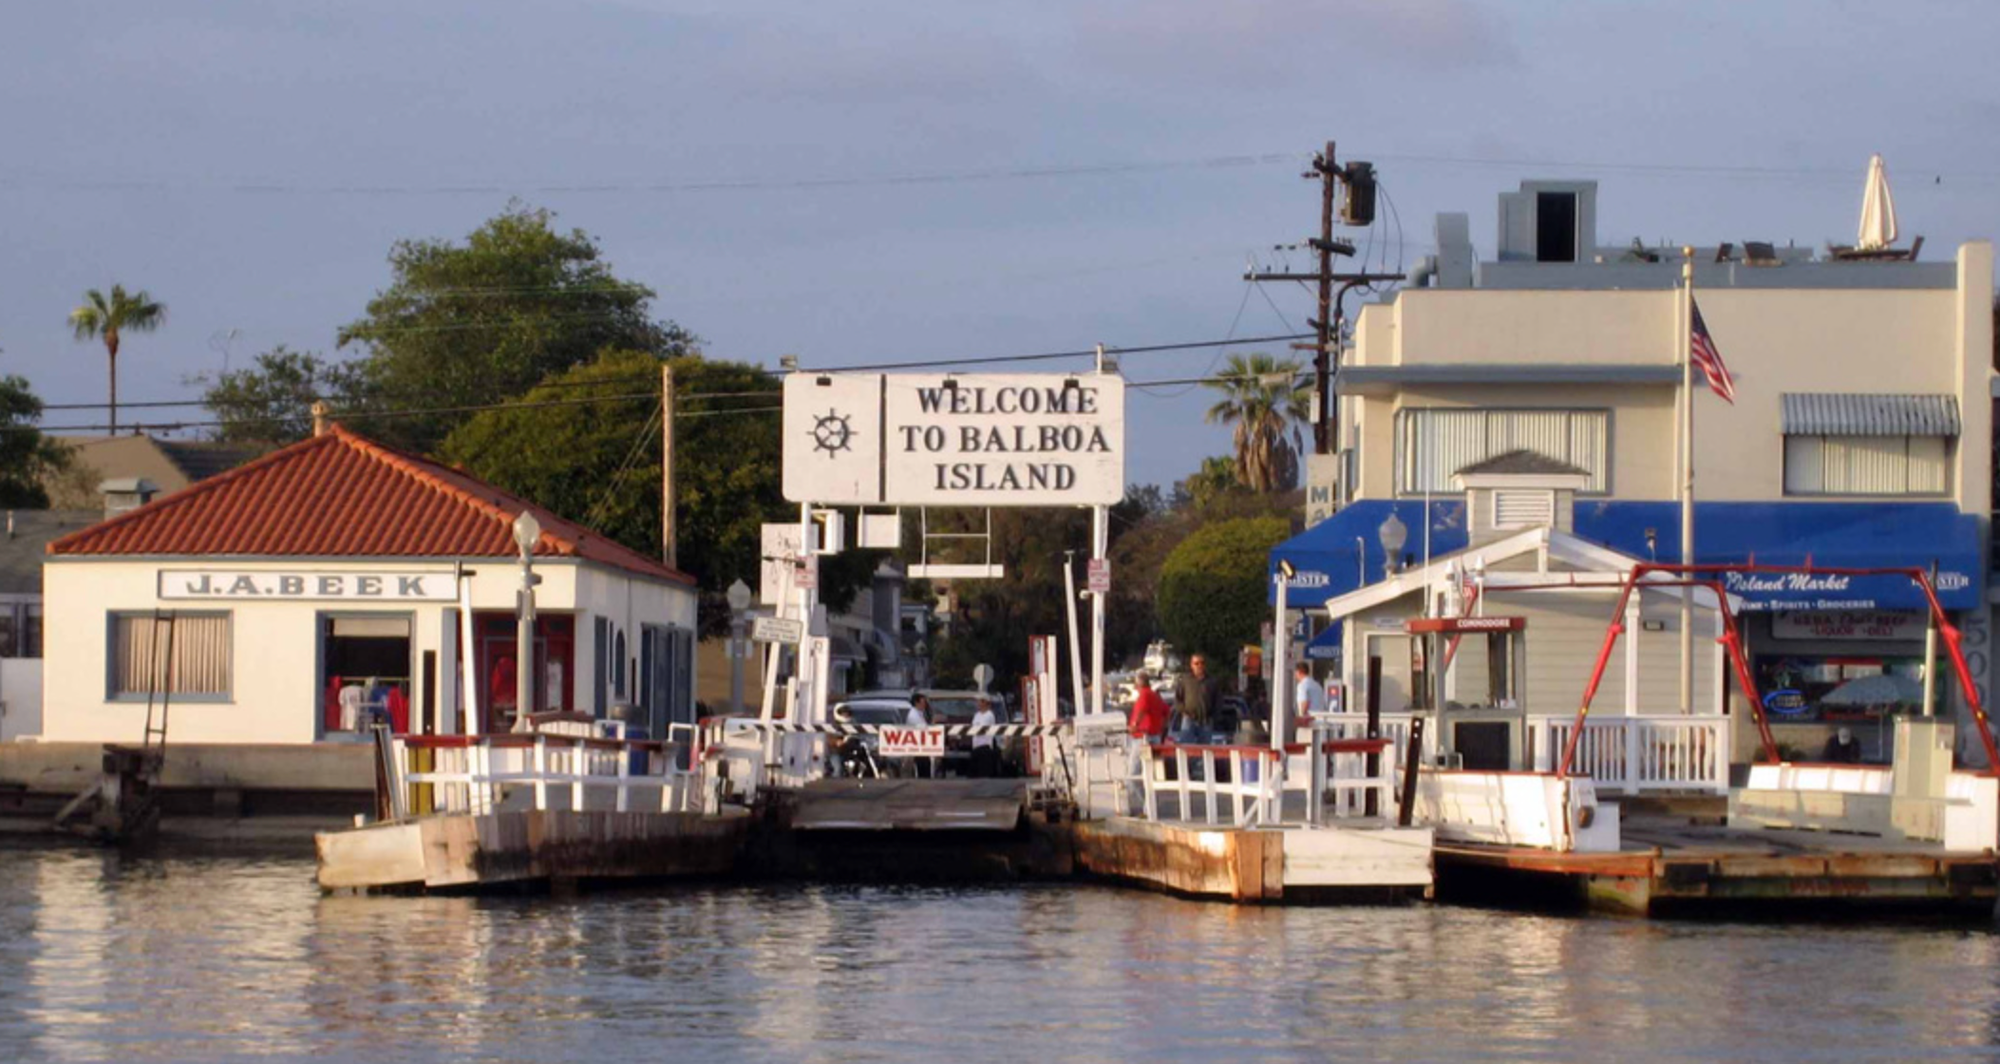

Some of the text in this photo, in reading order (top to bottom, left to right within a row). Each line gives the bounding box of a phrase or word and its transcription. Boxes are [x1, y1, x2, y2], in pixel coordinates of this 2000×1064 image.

[917, 387, 1098, 414] WELCOME
[899, 425, 1112, 452] TO BALBOA
[934, 463, 1076, 490] ISLAND
[1273, 572, 1330, 587] RGISTER
[1787, 572, 1849, 590] Market
[883, 730, 942, 746] WAIT
